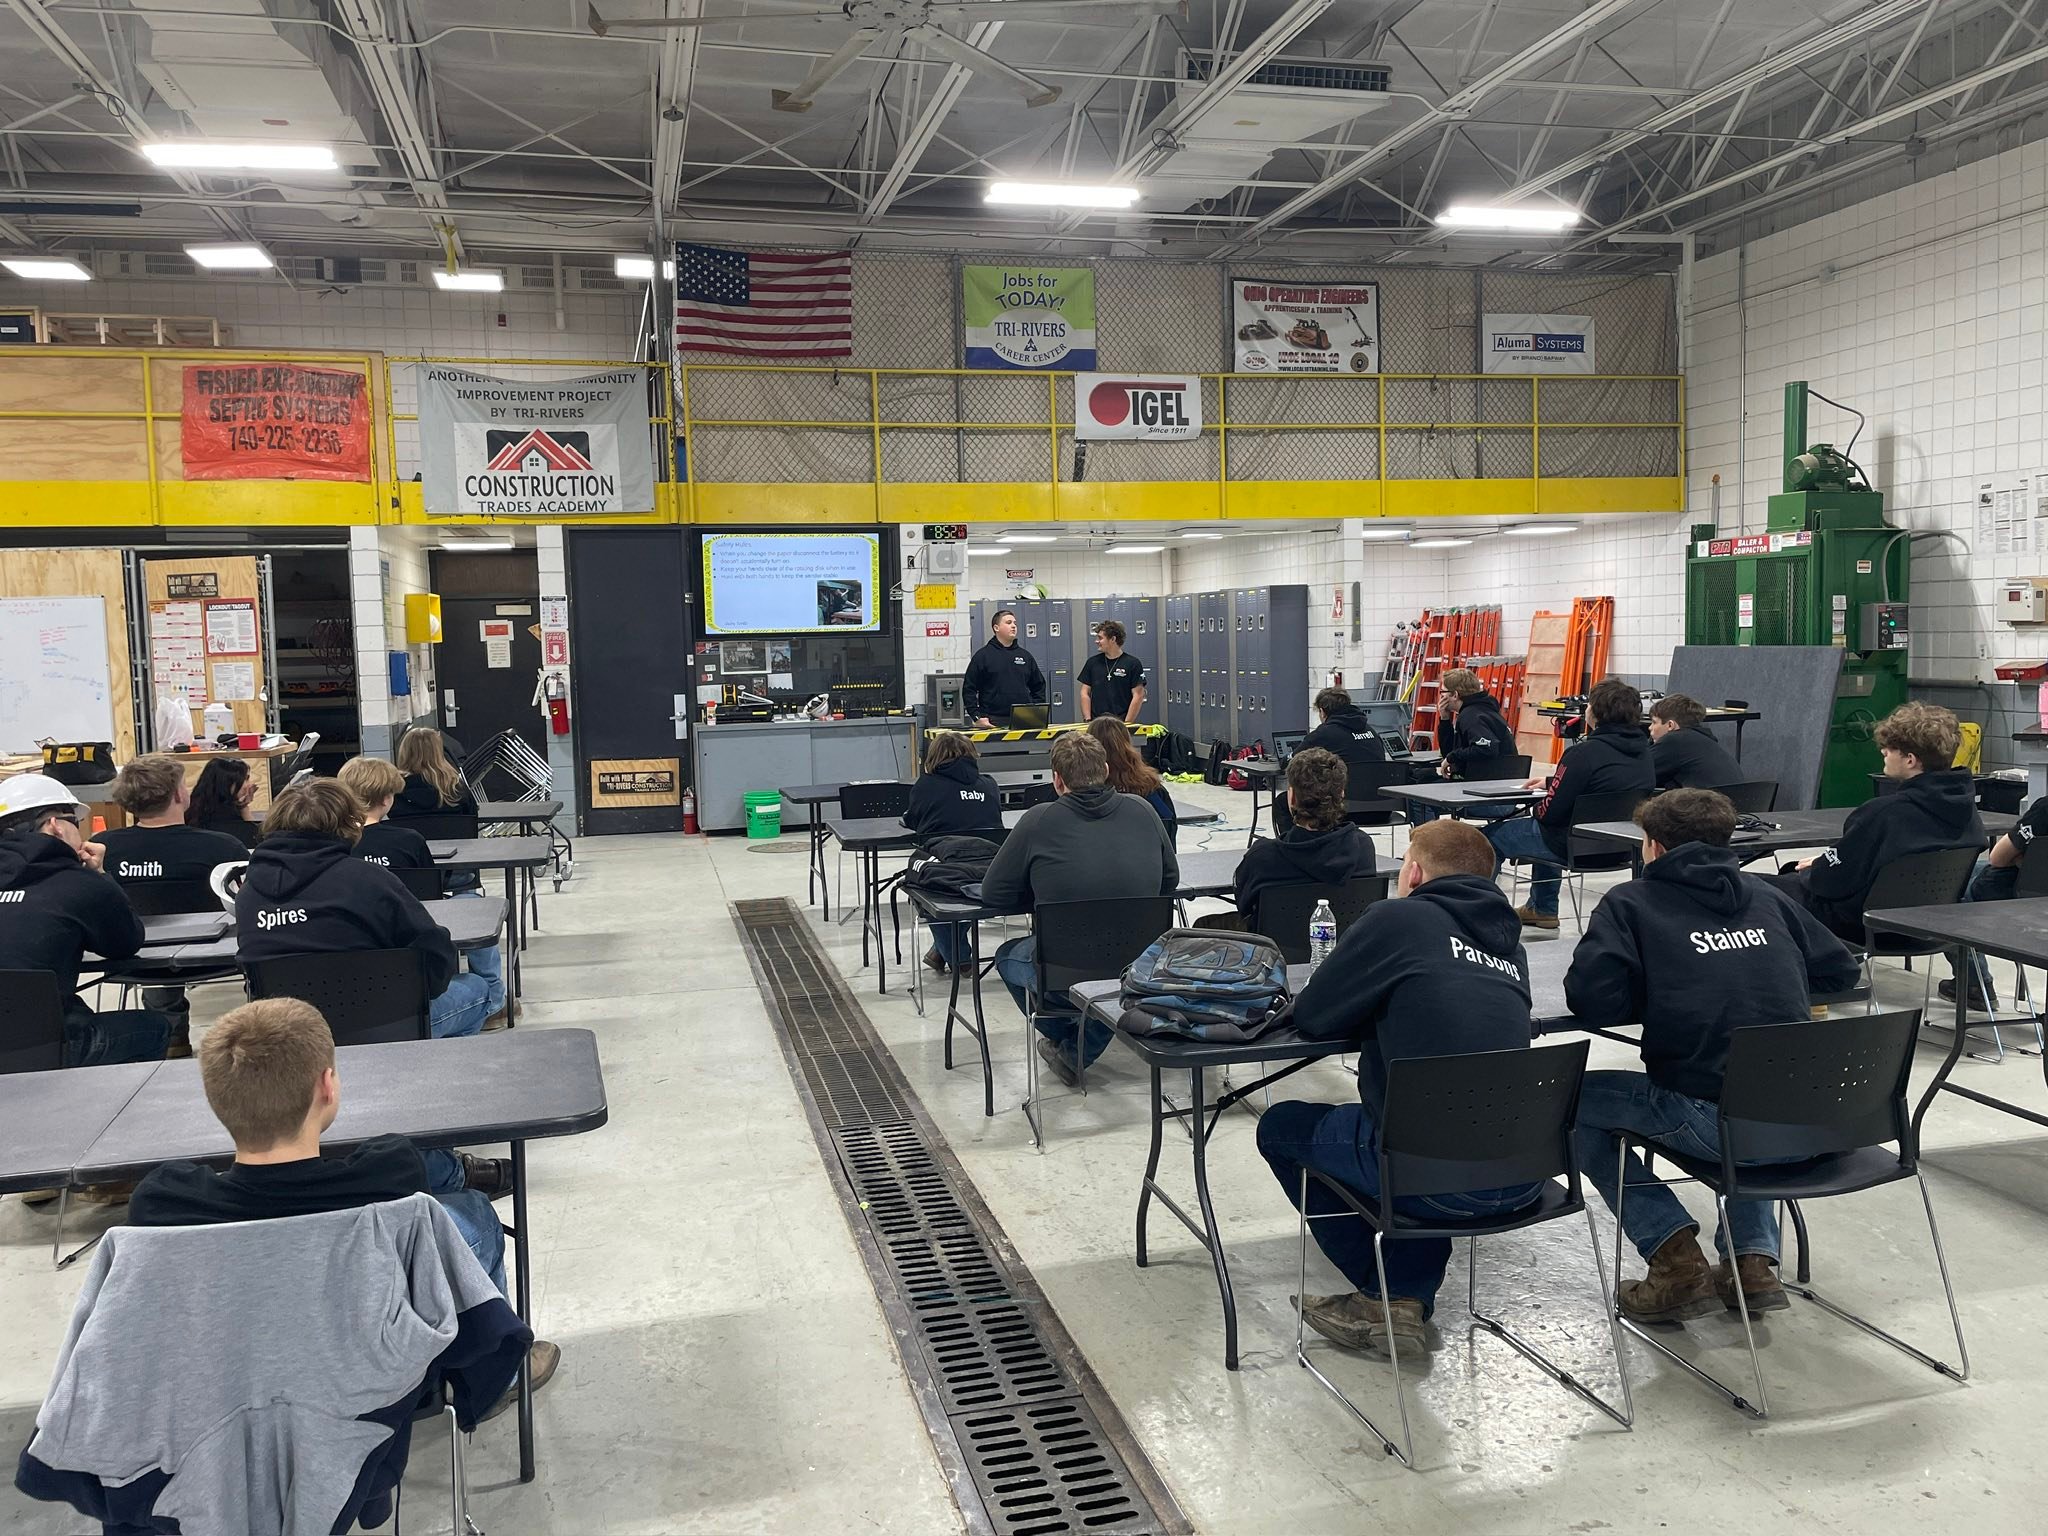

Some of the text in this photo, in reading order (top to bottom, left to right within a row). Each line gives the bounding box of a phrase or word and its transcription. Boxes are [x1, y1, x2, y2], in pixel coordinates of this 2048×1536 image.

[1003, 273, 1058, 289] Jobs for
[995, 291, 1065, 311] TODAY!
[995, 322, 1066, 337] TRI-RIVERS
[1497, 337, 1530, 348] Aluma
[995, 342, 1067, 362] CAREER CENTER
[578, 373, 636, 383] UNITY
[457, 389, 612, 403] IMPROVEMENT PROJECT
[209, 396, 268, 423] SEPTIC
[490, 407, 584, 418] BY TRI-RIVERS
[1131, 391, 1190, 426] IGEL
[465, 475, 614, 497] CONSTRUCTION
[477, 500, 608, 512] TRADES ACADEMY
[1733, 545, 1768, 555] COMPACTOR
[1738, 539, 1757, 547] BALER
[960, 790, 985, 802] Raby
[118, 861, 163, 877] Smith
[0, 890, 26, 903] nn
[257, 908, 308, 931] Spires
[1689, 927, 1768, 954] Stainer
[1449, 936, 1521, 982] Parsons
